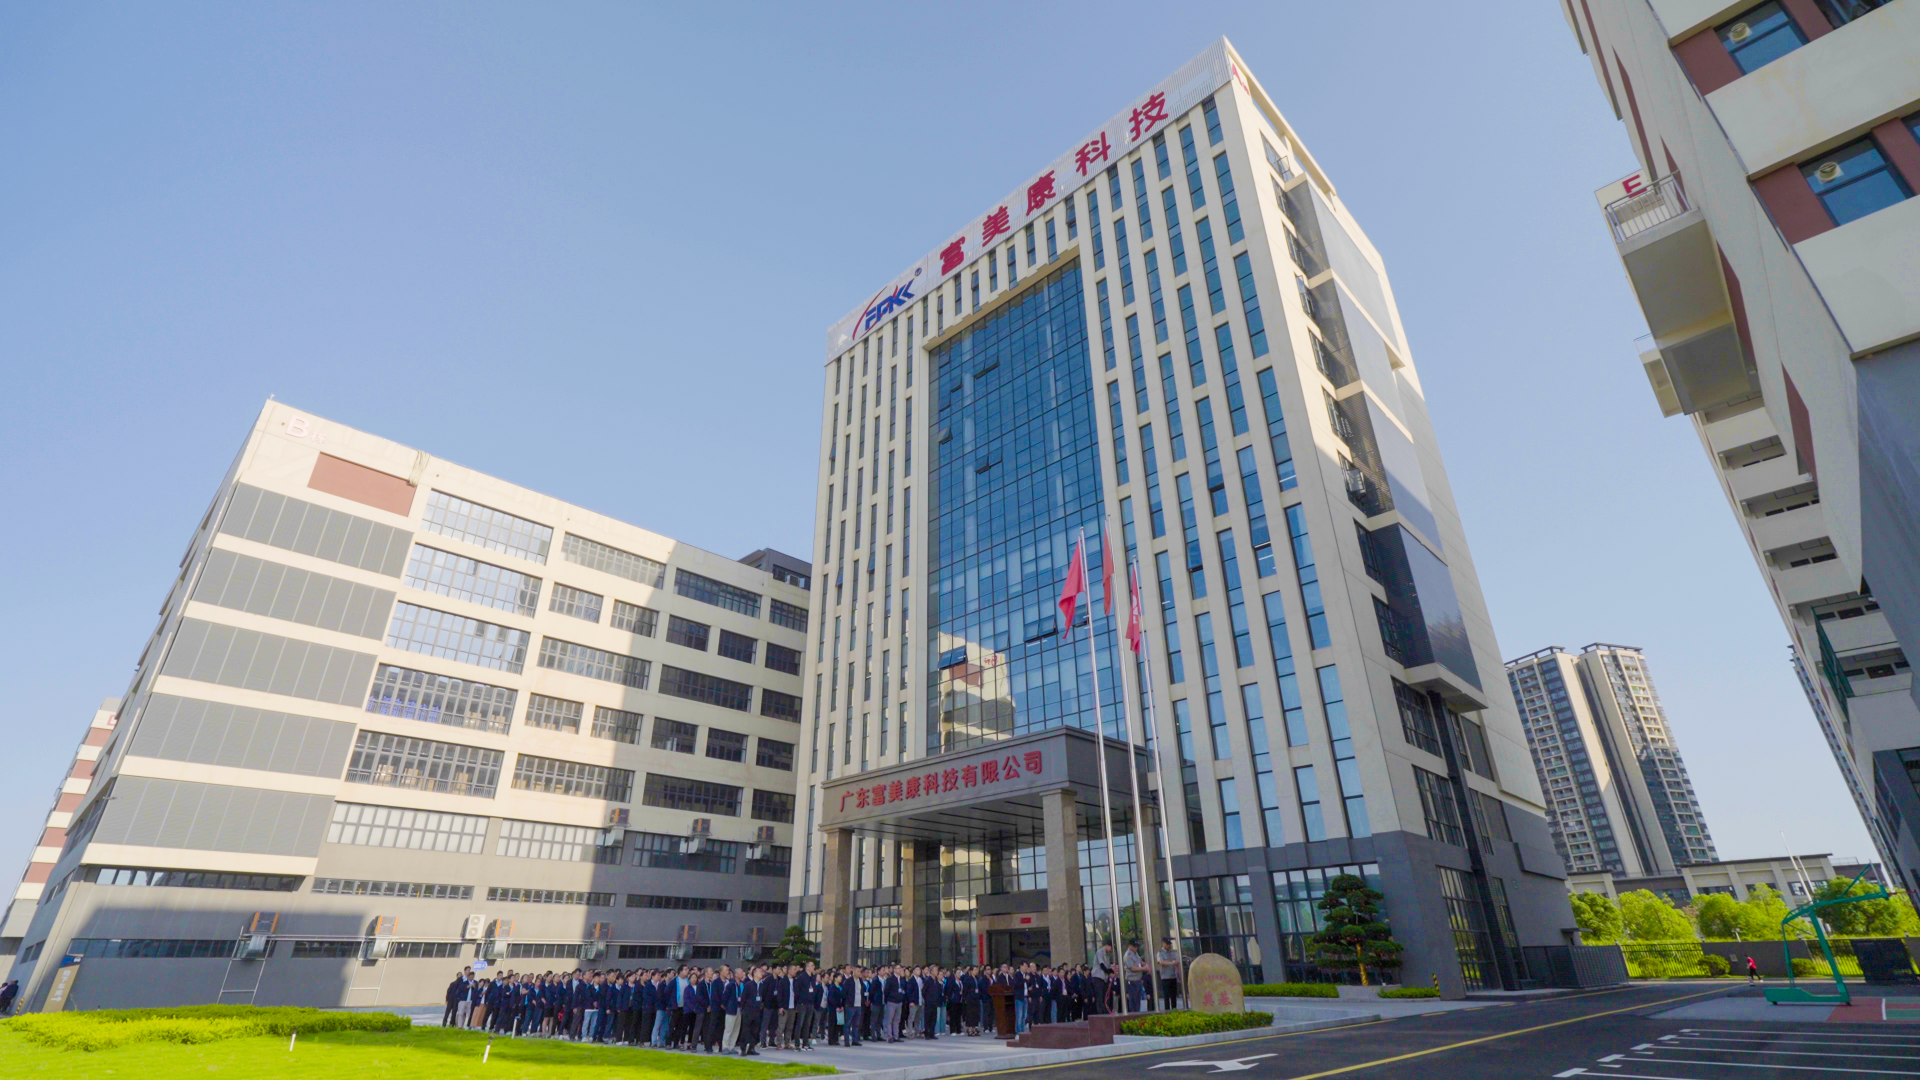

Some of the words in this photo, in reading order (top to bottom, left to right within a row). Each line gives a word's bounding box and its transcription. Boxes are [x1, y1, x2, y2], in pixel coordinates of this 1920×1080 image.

[940, 92, 1168, 276] 富美康科技
[839, 750, 1043, 812] 广东富美康科技有限公司
